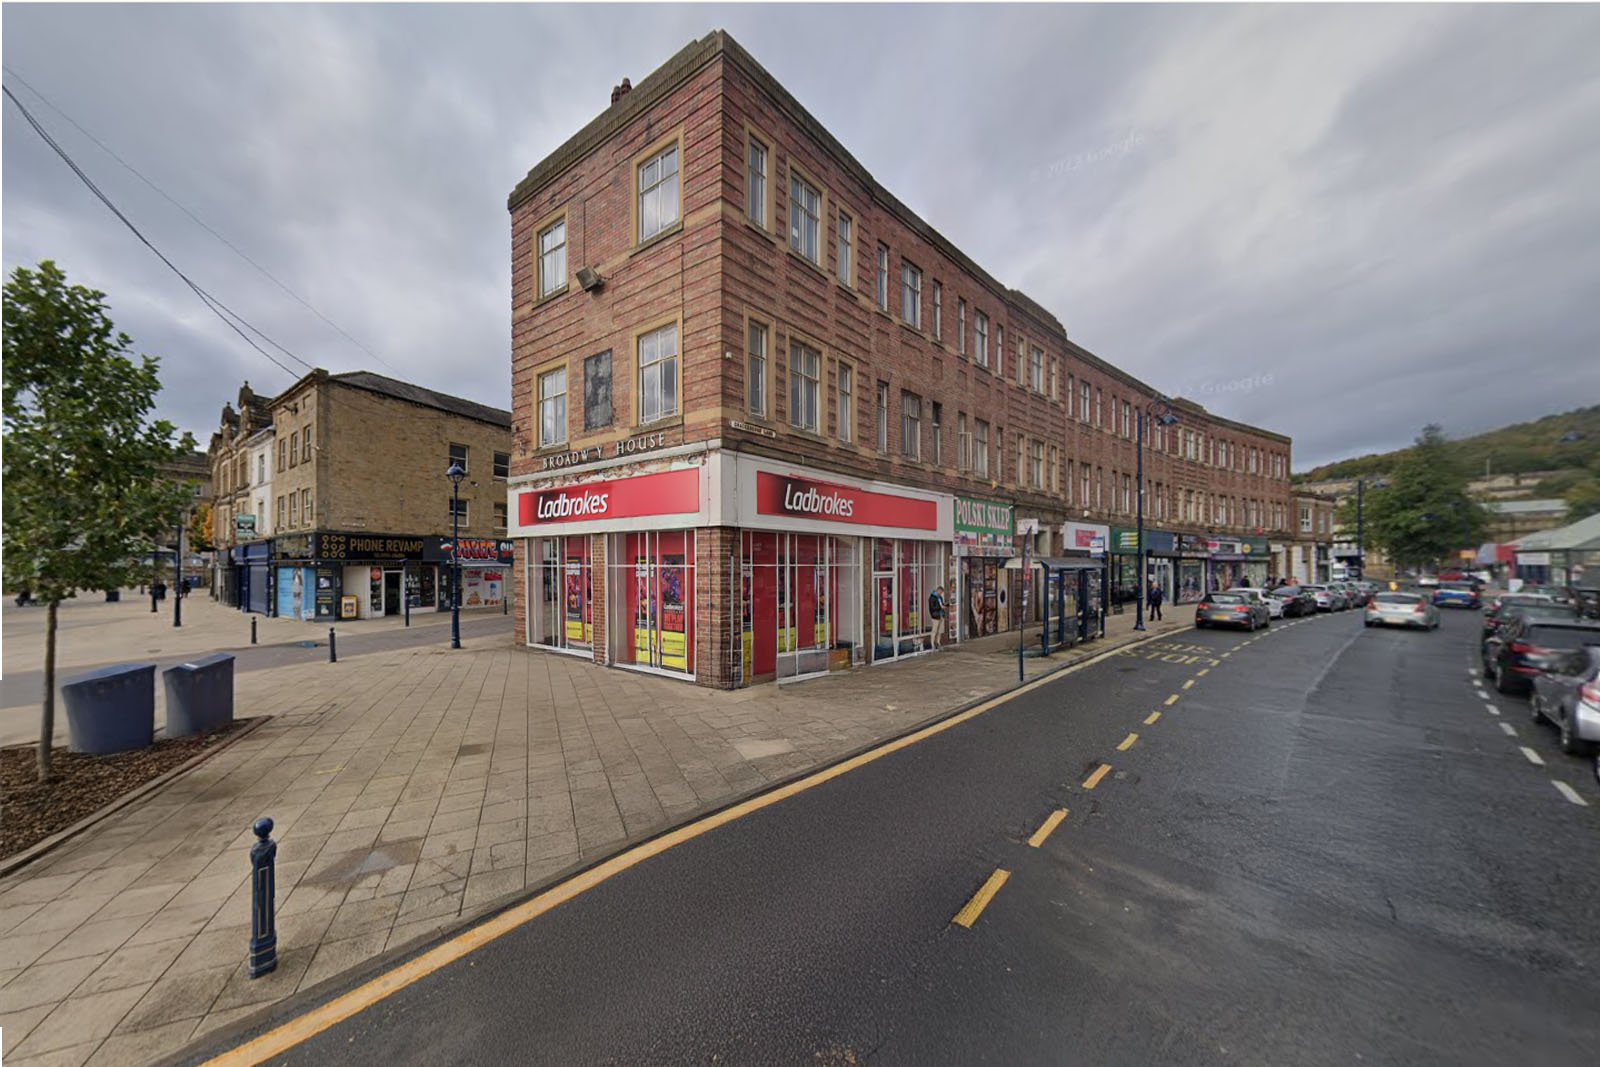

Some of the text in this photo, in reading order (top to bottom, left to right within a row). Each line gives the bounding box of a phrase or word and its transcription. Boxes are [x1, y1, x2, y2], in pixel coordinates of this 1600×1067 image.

[616, 433, 665, 455] HOUSE
[537, 490, 608, 518] Ladbrokes
[784, 483, 853, 517] Ladbrokes
[956, 499, 986, 528] POLSKI
[987, 505, 1010, 530] SKLEP
[349, 538, 424, 552] PHONE REVAMP
[1114, 648, 1220, 666] STOP
